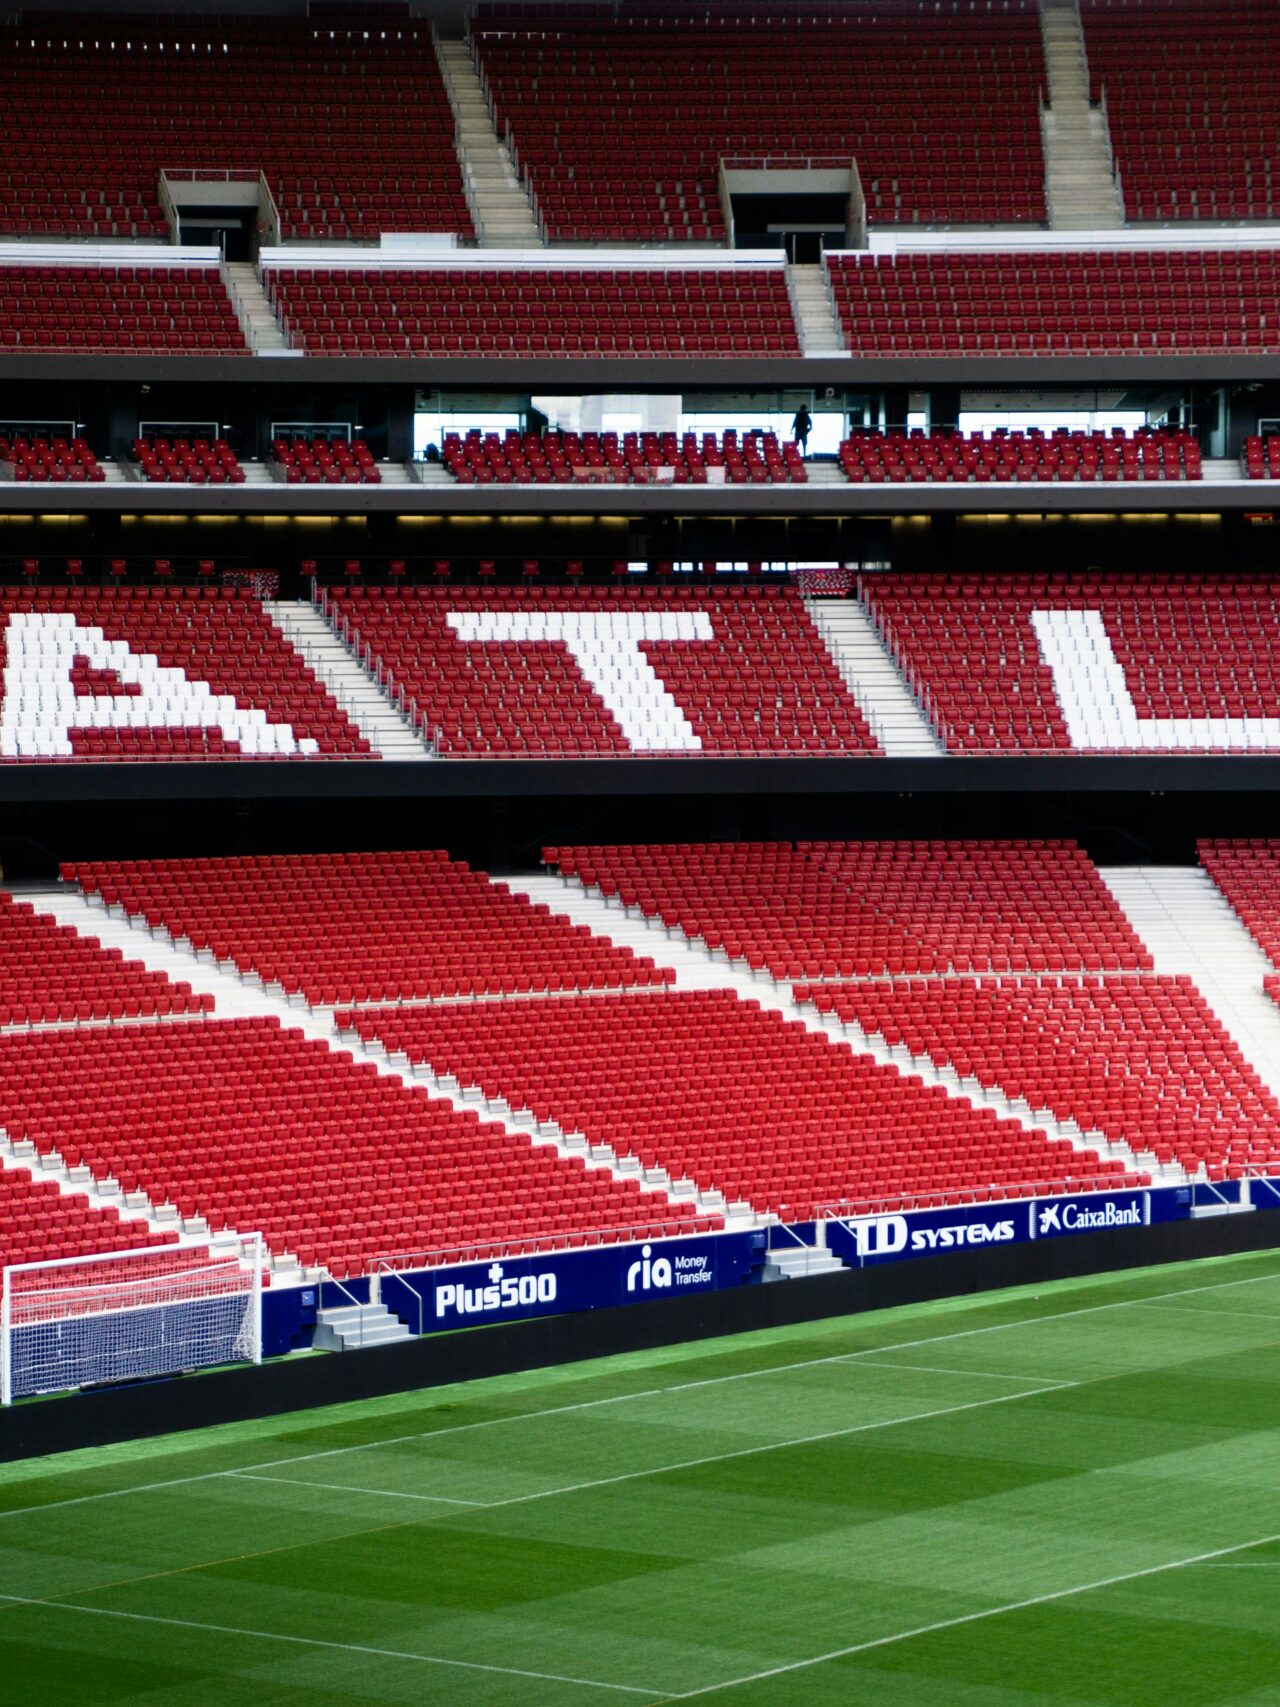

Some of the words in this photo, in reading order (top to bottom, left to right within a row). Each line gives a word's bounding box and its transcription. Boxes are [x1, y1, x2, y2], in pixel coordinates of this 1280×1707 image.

[1062, 1200, 1142, 1229] CaixaBank
[848, 1215, 908, 1256] TD
[911, 1220, 1015, 1250] SYSTEMS
[627, 1244, 672, 1291] ria
[675, 1256, 708, 1271] Money
[675, 1270, 713, 1285] Transfer
[436, 1272, 557, 1317] Plus500
